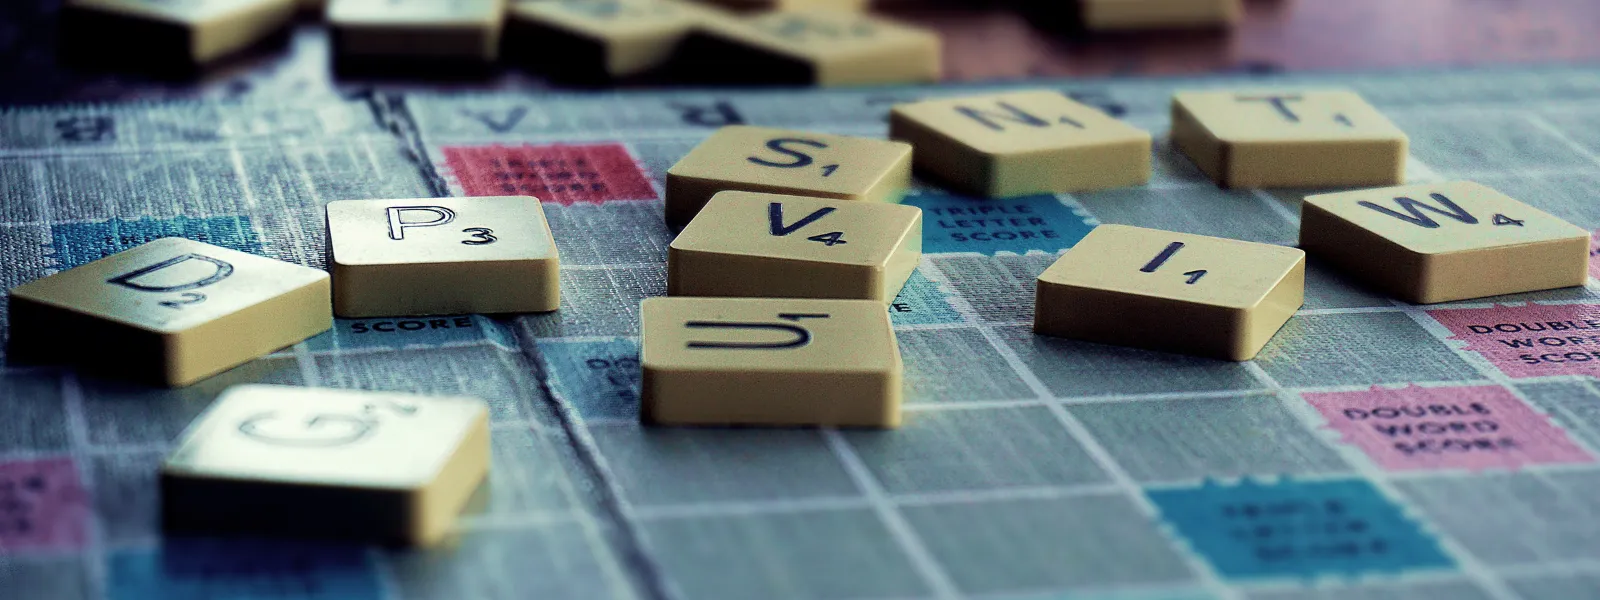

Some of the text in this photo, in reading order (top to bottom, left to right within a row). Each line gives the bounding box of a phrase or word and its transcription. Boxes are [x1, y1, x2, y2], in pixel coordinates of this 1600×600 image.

[953, 101, 1086, 131] N 1
[1234, 96, 1355, 127] T 1
[746, 138, 839, 177] S 1
[386, 206, 498, 245] P 3
[768, 202, 847, 246] V 4
[929, 204, 1034, 217] TRIPLE
[937, 216, 1048, 230] LETTER
[1357, 192, 1525, 229] W 4
[950, 229, 1061, 242] SCORE
[106, 252, 235, 293] D
[1139, 241, 1208, 285] I 1
[157, 292, 208, 309] 2
[350, 316, 474, 335] SCORE
[684, 312, 831, 350] U 1
[1343, 402, 1492, 421] DOUBLE
[237, 410, 380, 450] G
[1373, 419, 1499, 437] WORD
